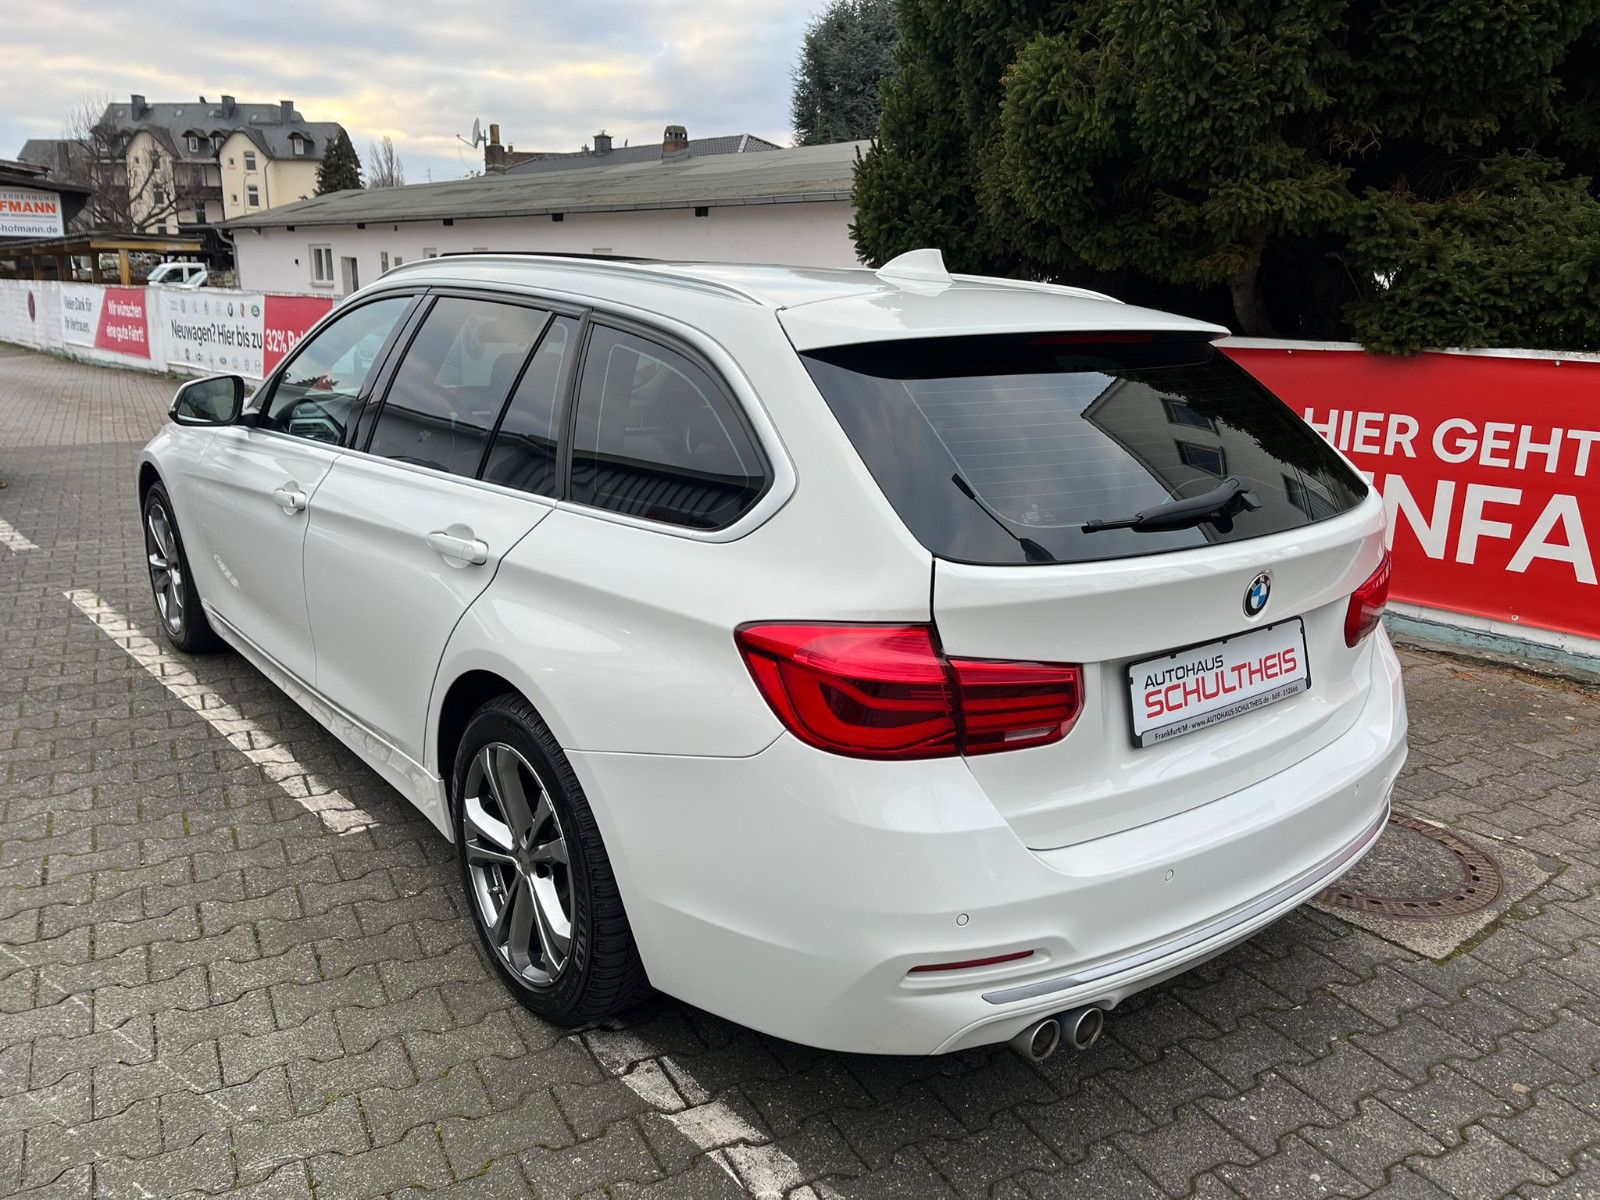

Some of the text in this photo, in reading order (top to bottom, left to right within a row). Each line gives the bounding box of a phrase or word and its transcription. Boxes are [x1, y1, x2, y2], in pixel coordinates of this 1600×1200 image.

[116, 301, 142, 318] wünschen
[170, 319, 216, 346] Neuwagen?
[217, 324, 235, 345] Hier
[236, 325, 250, 347] bis
[250, 333, 262, 349] zu
[266, 329, 287, 353] 32%
[1304, 407, 1600, 476] HIER GEHT
[1144, 655, 1224, 690] AUTOHAUS
[1144, 647, 1297, 719] SCHULTHEIS
